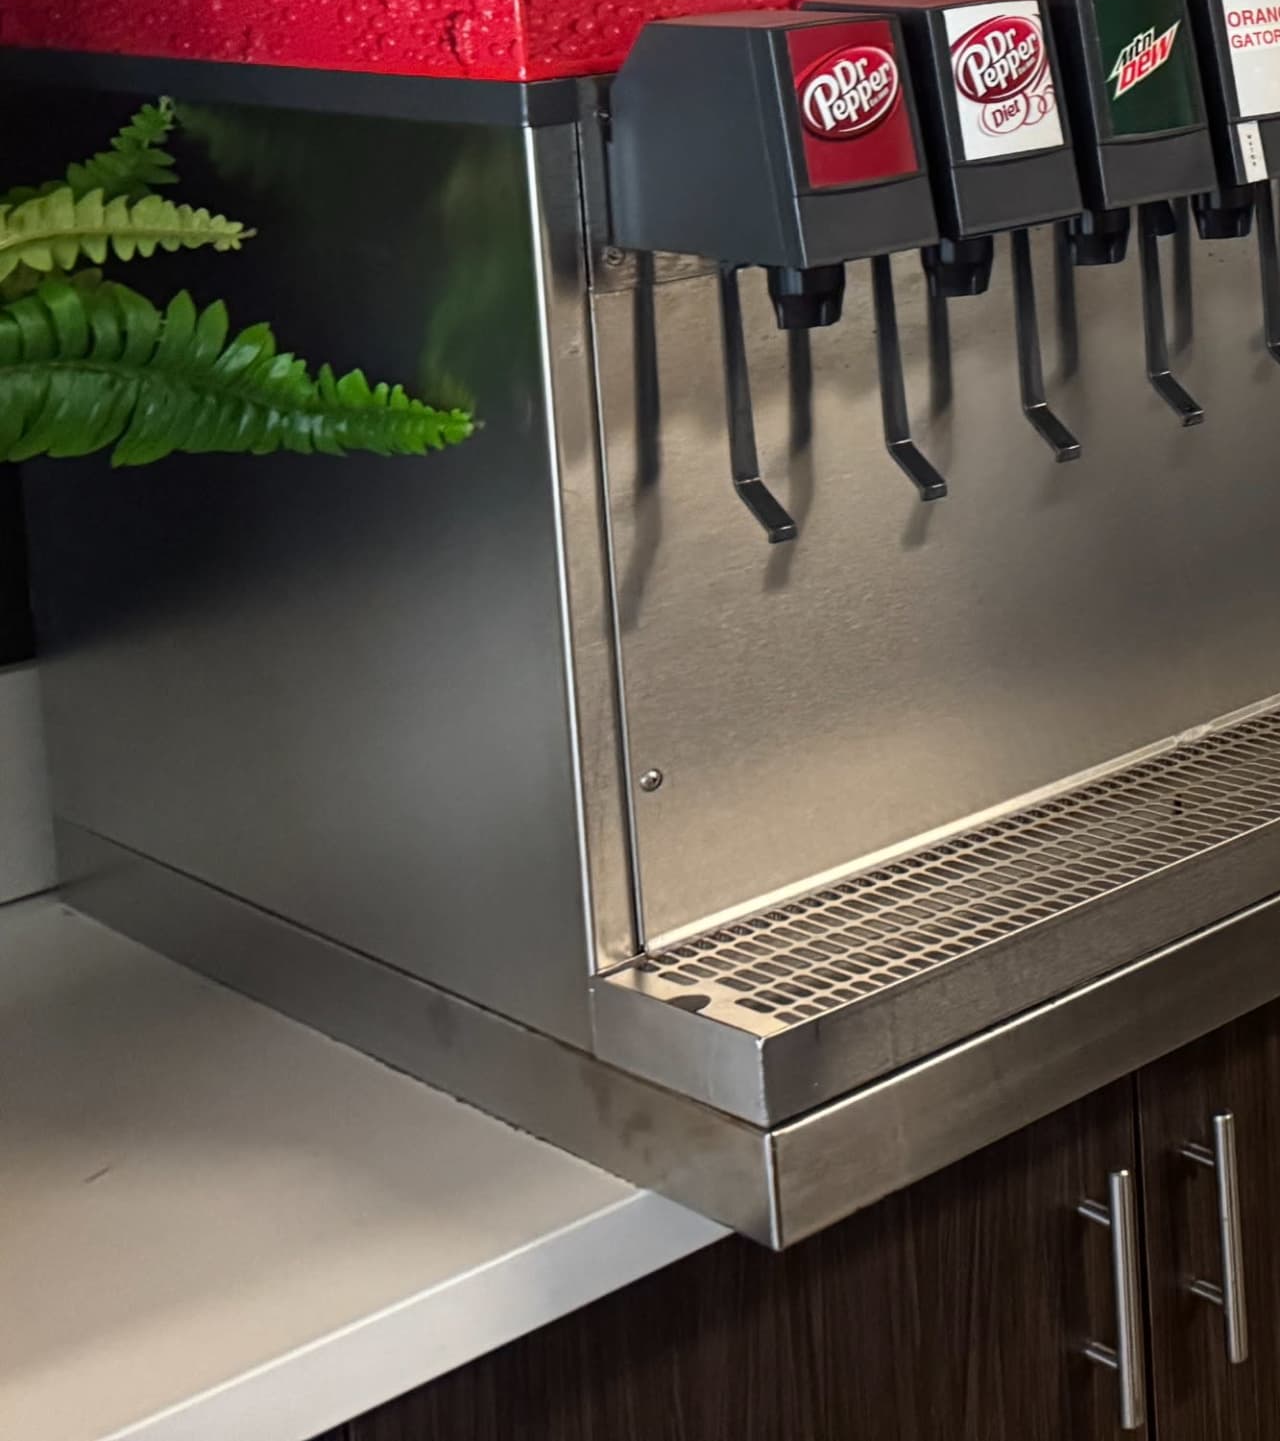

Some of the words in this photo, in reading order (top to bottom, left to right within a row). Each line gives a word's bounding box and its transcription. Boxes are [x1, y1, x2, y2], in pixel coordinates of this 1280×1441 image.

[988, 27, 1018, 59] Dr
[833, 56, 868, 91] Dr
[966, 30, 1038, 97] Pepper
[813, 61, 892, 132] Pepper
[991, 99, 1021, 128] Diet
